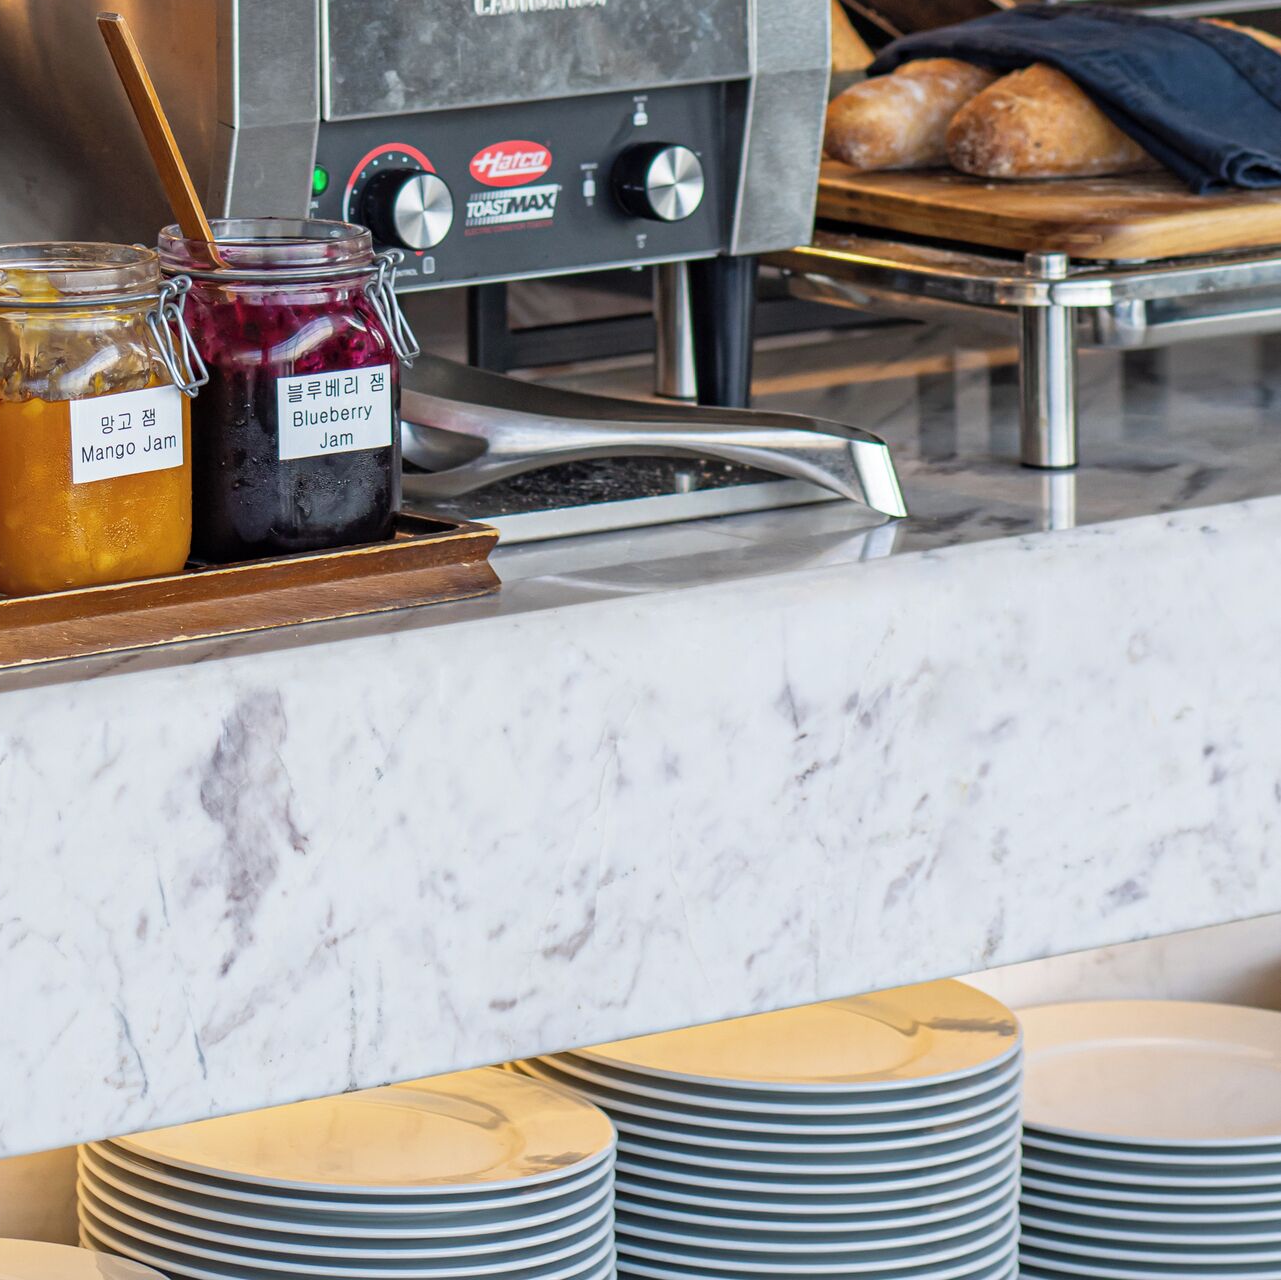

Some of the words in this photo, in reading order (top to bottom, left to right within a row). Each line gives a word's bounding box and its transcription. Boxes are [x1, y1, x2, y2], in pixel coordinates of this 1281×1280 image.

[474, 151, 548, 178] Hatco
[287, 376, 358, 403] 블루베리
[370, 372, 384, 392] 잼
[101, 413, 132, 434] 망고
[142, 408, 156, 427] 잼
[293, 405, 372, 427] Blueberry
[81, 442, 136, 463] Mango
[143, 434, 177, 453] Jam
[320, 432, 353, 449] Jam
